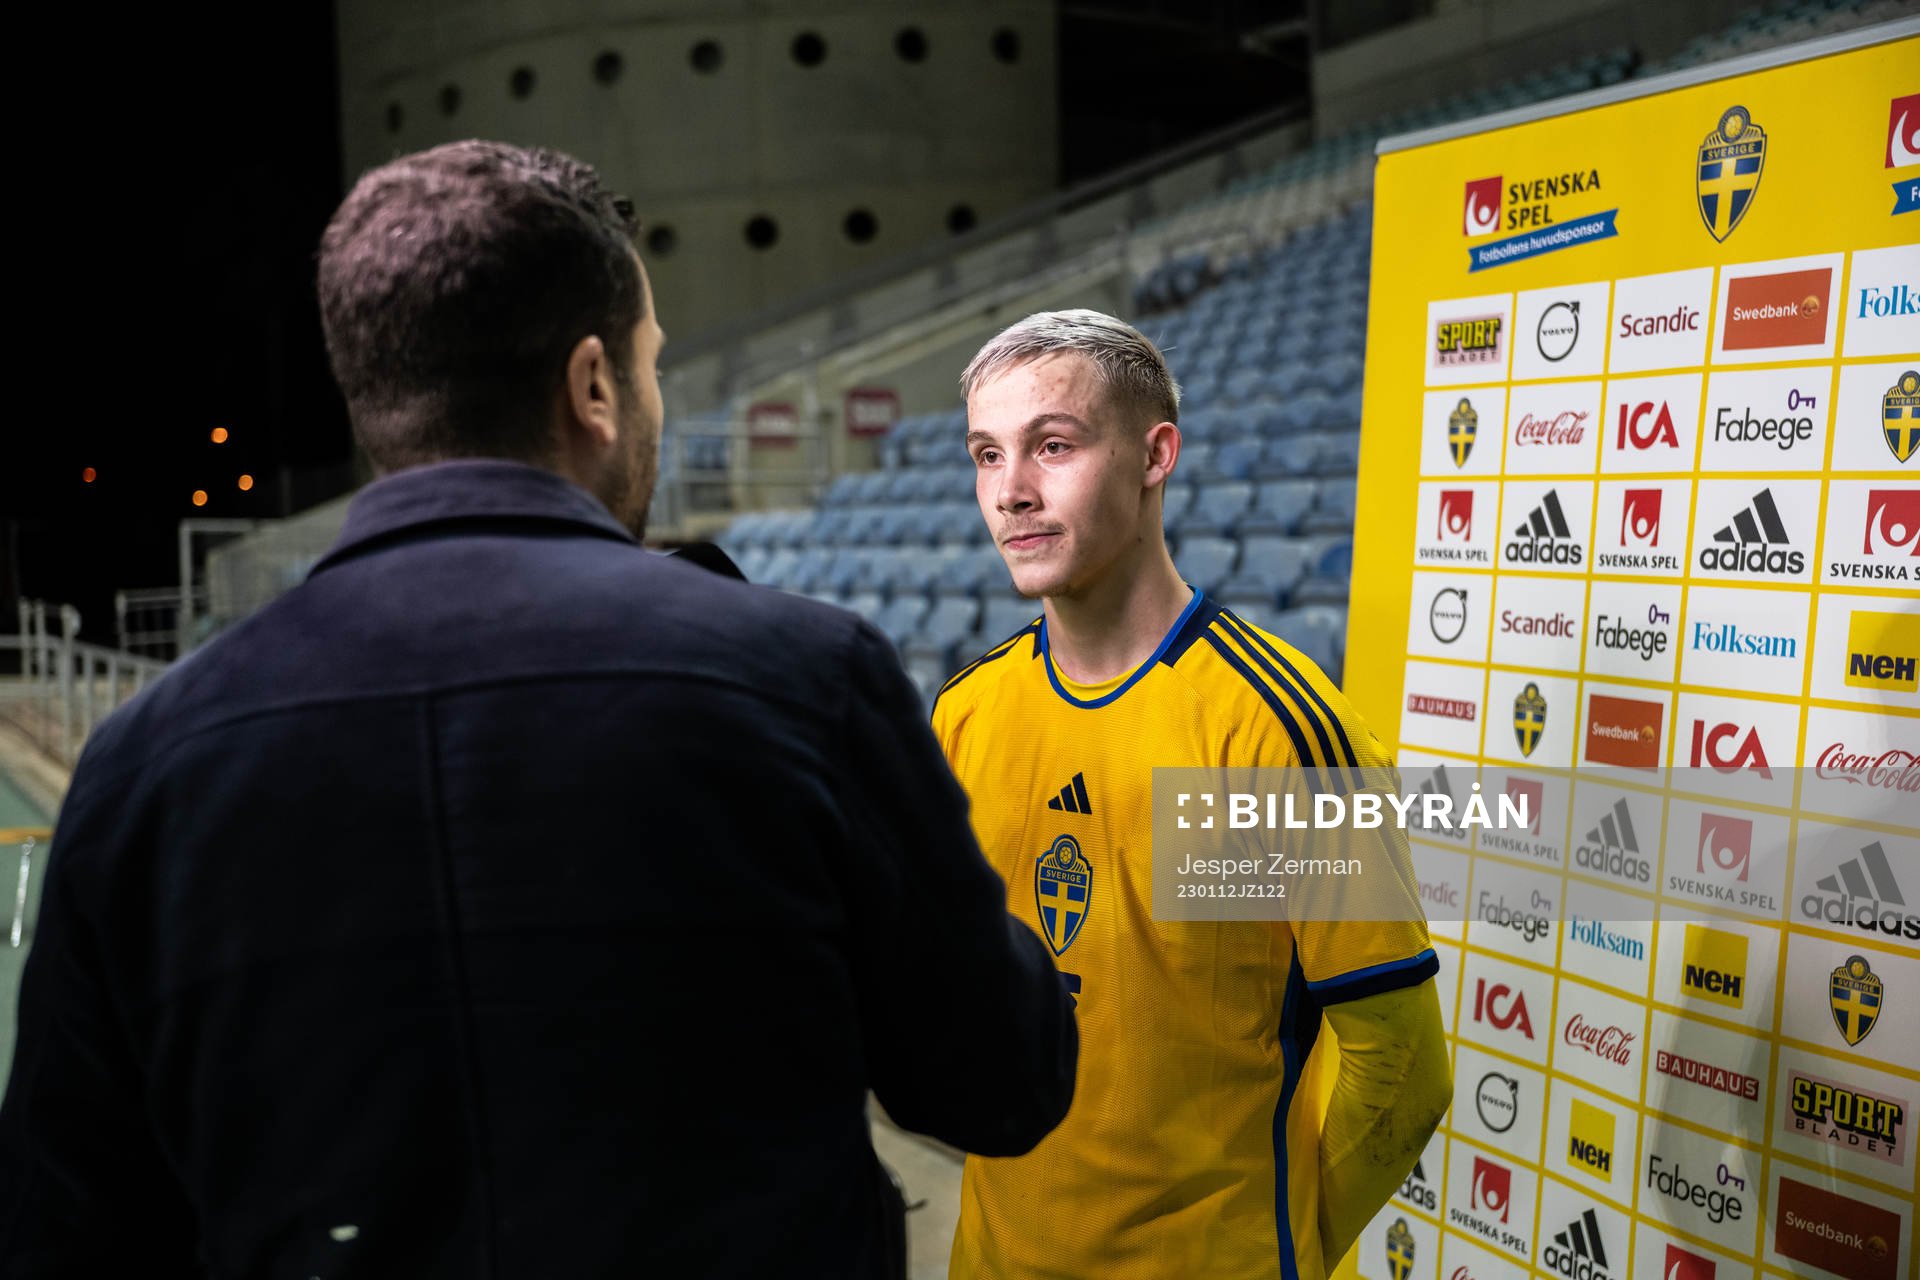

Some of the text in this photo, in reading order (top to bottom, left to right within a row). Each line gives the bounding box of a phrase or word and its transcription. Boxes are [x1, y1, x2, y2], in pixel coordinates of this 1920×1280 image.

[1706, 142, 1755, 160] SVERIGE
[1508, 168, 1601, 205] SVENSKA
[1507, 204, 1553, 230] SPEL
[1530, 221, 1605, 250] huvudsponsor
[1620, 306, 1699, 338] Scandic
[1733, 302, 1798, 321] Swedbank
[1437, 318, 1501, 353] SPORT
[1439, 351, 1497, 364] BLADET
[1617, 400, 1679, 450] ICA
[1715, 407, 1812, 450] Fabege
[1419, 548, 1488, 561] SVENSKA SPEL
[1505, 537, 1582, 565] adidas
[1599, 554, 1679, 569] SVENSKA SPEL
[1699, 542, 1805, 574] adidas
[1830, 563, 1908, 580] SVENSKA
[1501, 610, 1575, 638] Scandic
[1596, 615, 1667, 661] Fabege
[1692, 622, 1796, 658] Folksam
[1408, 695, 1475, 720] BAUHAUS
[1592, 722, 1639, 741] Swedbank
[1690, 719, 1773, 780] ICA
[1482, 832, 1559, 862] SVENSKA SPEL
[1576, 844, 1651, 883] adidas
[1046, 869, 1082, 883] SVERIGE
[1669, 876, 1777, 911] SVENSKA SPEL
[1478, 891, 1549, 943] Fabege
[1800, 893, 1920, 941] adidas
[1571, 914, 1644, 960] Folksam
[1473, 978, 1535, 1041] ICA
[1657, 1051, 1758, 1098] BAUHAUS
[1792, 1076, 1903, 1145] SPORT
[1796, 1118, 1896, 1157] BLADET
[1647, 1155, 1743, 1224] Fabege
[1450, 1208, 1528, 1254] SVENSKA SPEL
[1785, 1211, 1864, 1250] Swedbank
